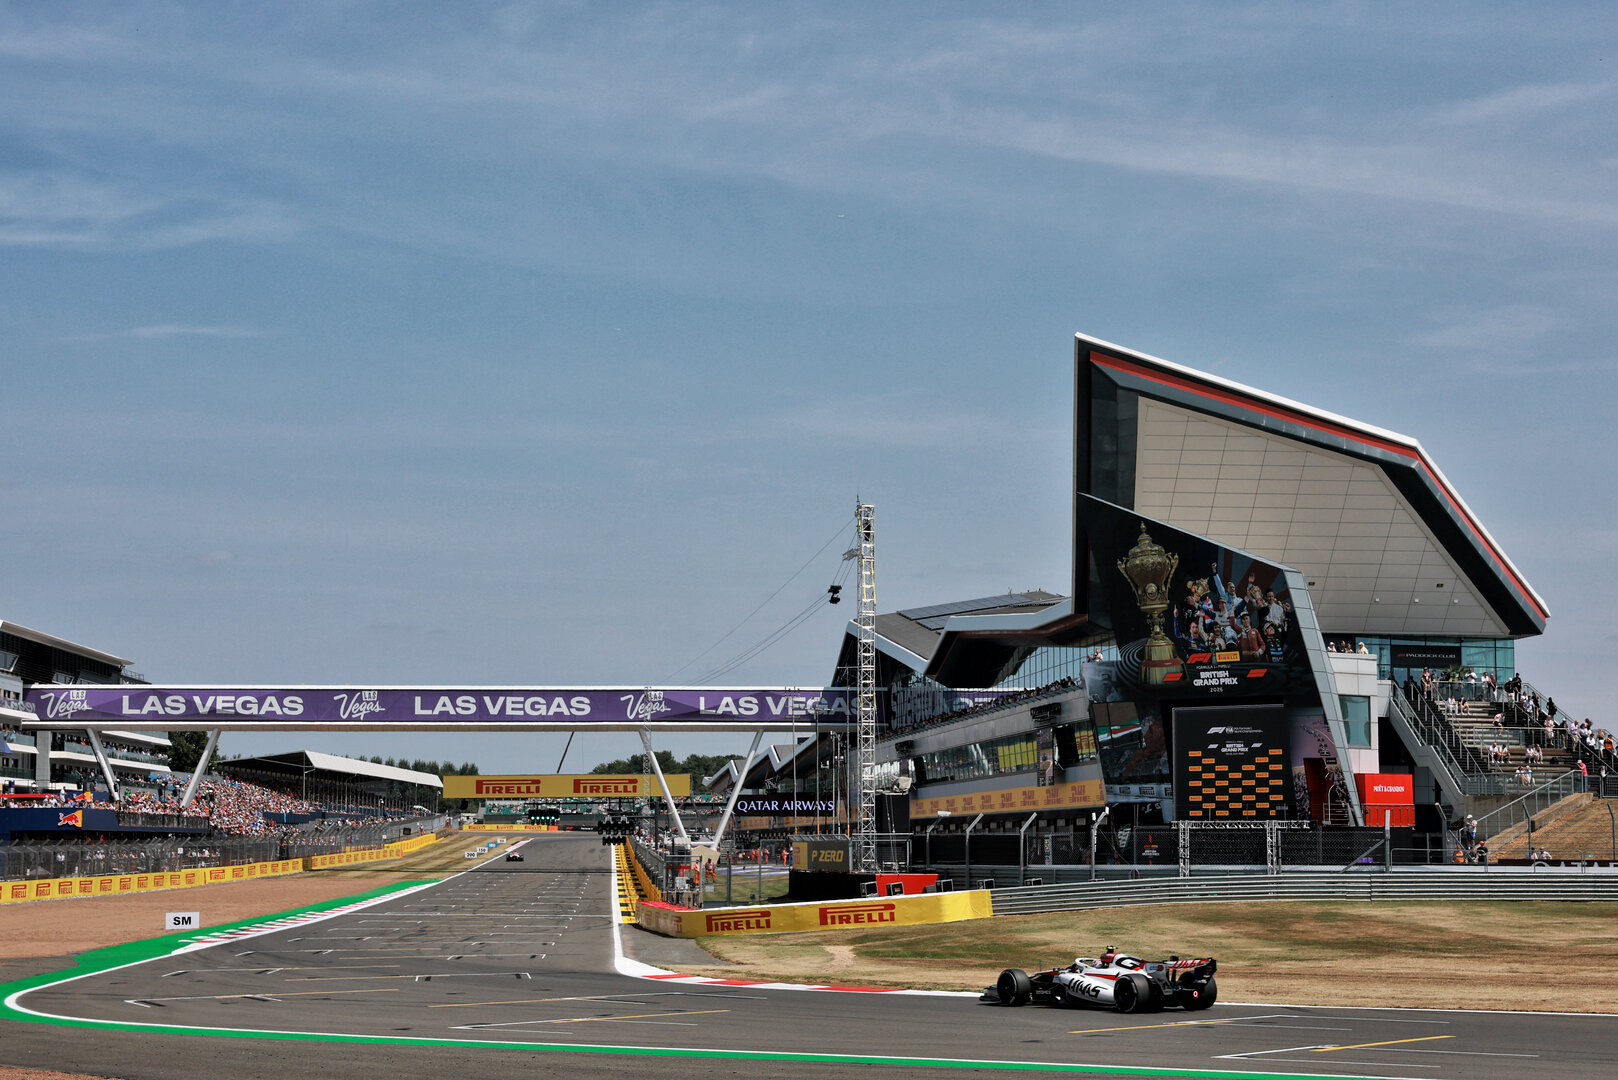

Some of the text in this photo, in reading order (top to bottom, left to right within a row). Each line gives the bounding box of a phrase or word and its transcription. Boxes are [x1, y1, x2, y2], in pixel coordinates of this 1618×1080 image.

[1200, 670, 1229, 678] BRITISH
[41, 692, 92, 718] Vegas
[122, 696, 304, 715] LAS VEGAS
[363, 692, 377, 700] LAS
[414, 696, 591, 715] LAS VEGAS
[700, 696, 759, 715] LAS
[334, 692, 386, 720] Vegas
[620, 694, 671, 720] Vegas
[476, 779, 541, 794] PIRELLI
[573, 779, 638, 793] PIRELLI
[738, 801, 834, 812] QATAR AIRWAYS
[812, 850, 817, 862] P
[818, 850, 844, 862] ZERO
[173, 915, 192, 926] SM
[706, 910, 771, 932] PIRELLI
[819, 904, 896, 925] PIRELLI
[1066, 978, 1108, 998] HAAS
